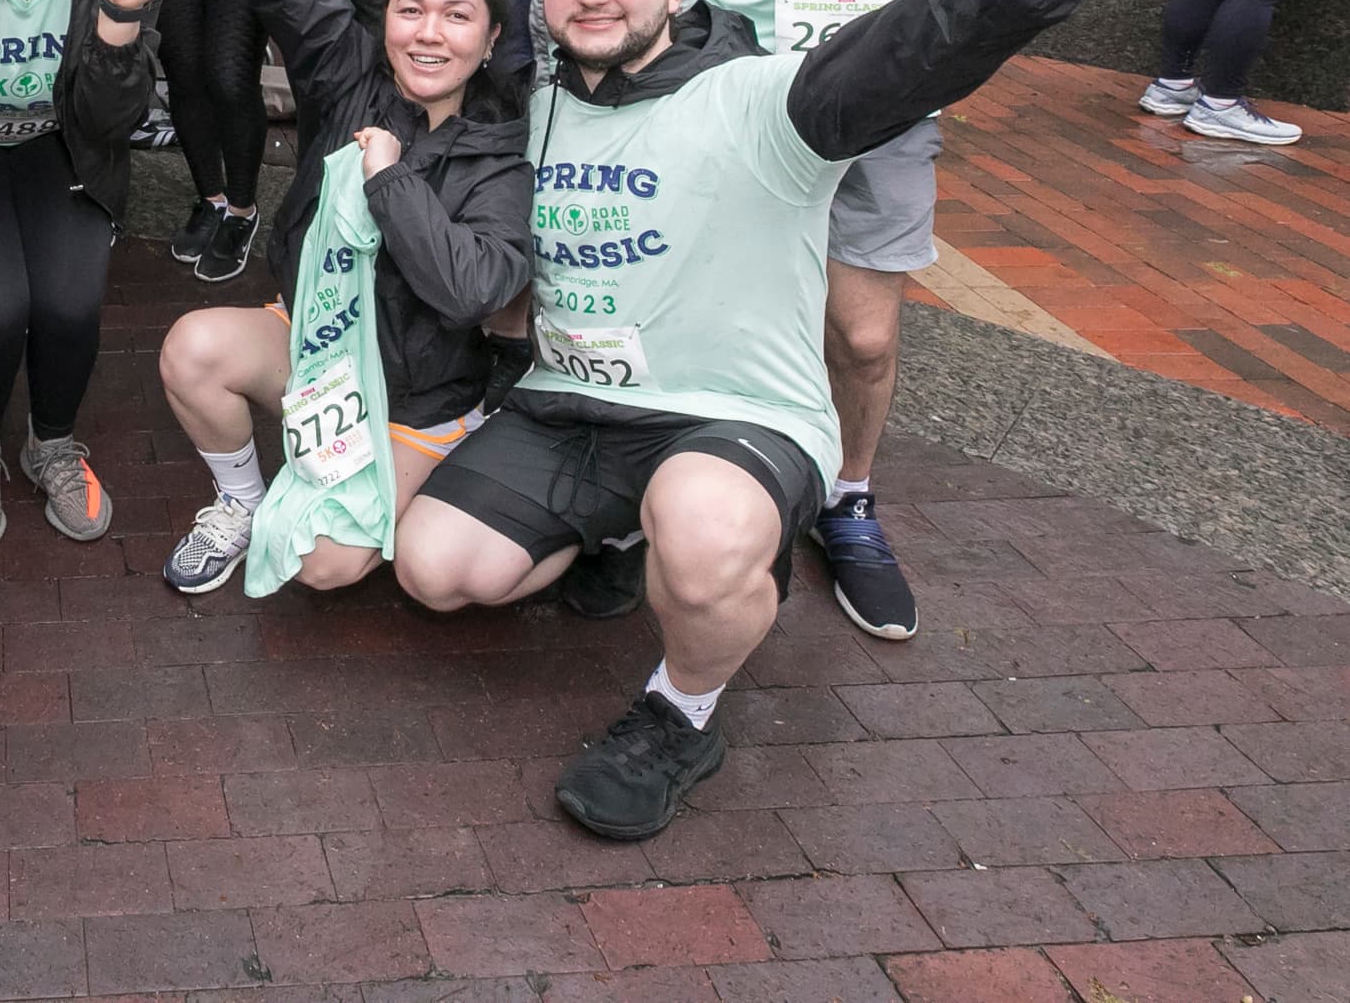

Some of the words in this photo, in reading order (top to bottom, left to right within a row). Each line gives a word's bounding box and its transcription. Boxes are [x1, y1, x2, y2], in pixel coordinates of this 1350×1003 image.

[793, 2, 842, 12] SPRING
[537, 205, 562, 230] 5K
[591, 205, 629, 219] ROAD
[593, 218, 631, 232] RACE
[554, 289, 617, 315] 2023
[576, 340, 625, 348] CLASSIC
[551, 348, 640, 387] 3052
[287, 391, 369, 459] 2722
[317, 446, 335, 463] 5K
